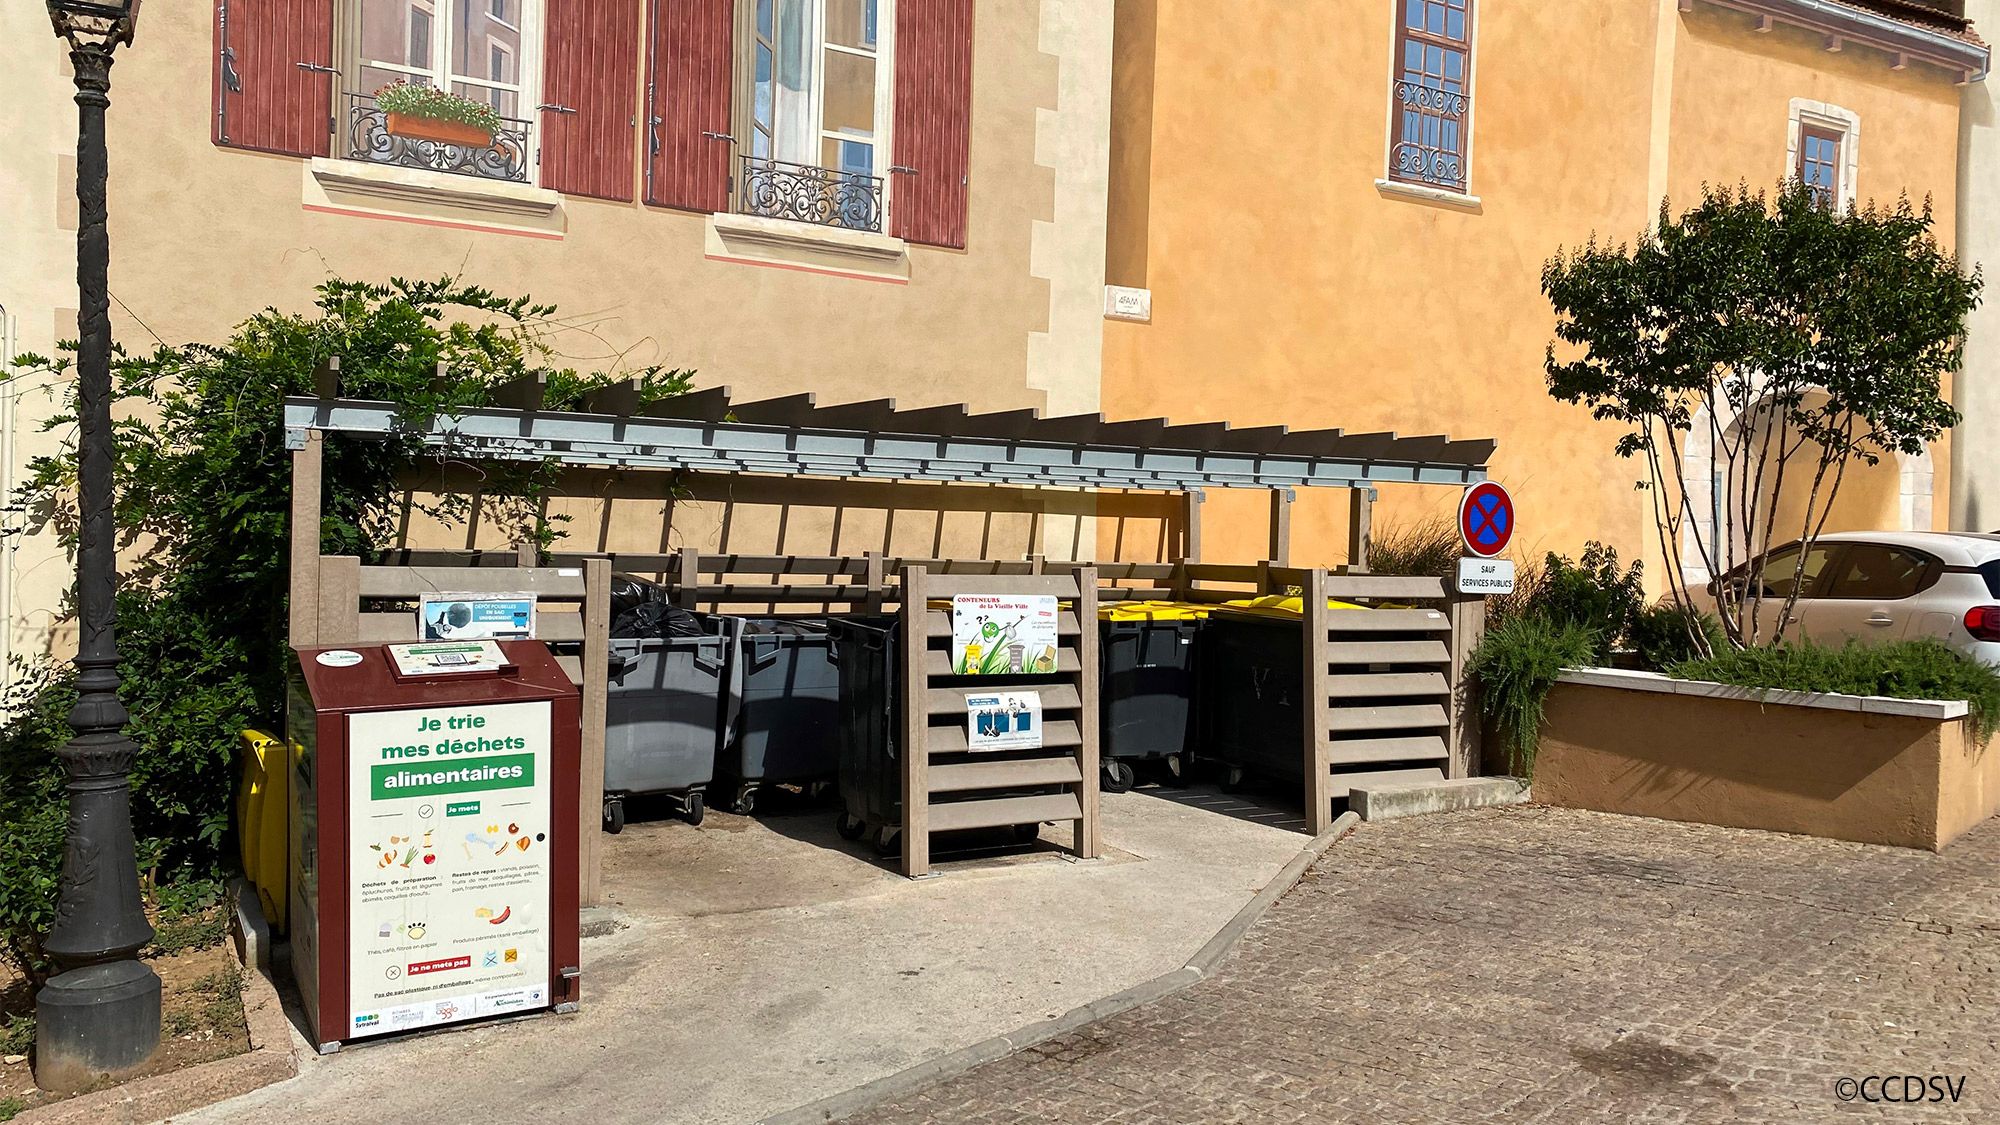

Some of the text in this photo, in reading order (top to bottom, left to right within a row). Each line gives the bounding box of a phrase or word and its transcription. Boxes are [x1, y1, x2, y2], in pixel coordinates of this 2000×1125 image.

[1481, 565, 1496, 573] SAUF
[1462, 578, 1512, 588] SERVICES PUBLICS
[417, 714, 486, 732] Je trie
[381, 735, 526, 759] mes déchets
[384, 764, 523, 789] alimentaires
[447, 804, 479, 814] Je mets
[403, 875, 437, 884] préparation
[452, 936, 475, 944] Produits
[475, 933, 497, 942] périmés
[512, 927, 540, 936] emballage)
[432, 961, 453, 969] mets
[453, 959, 469, 967] pas
[405, 986, 431, 995] plastique
